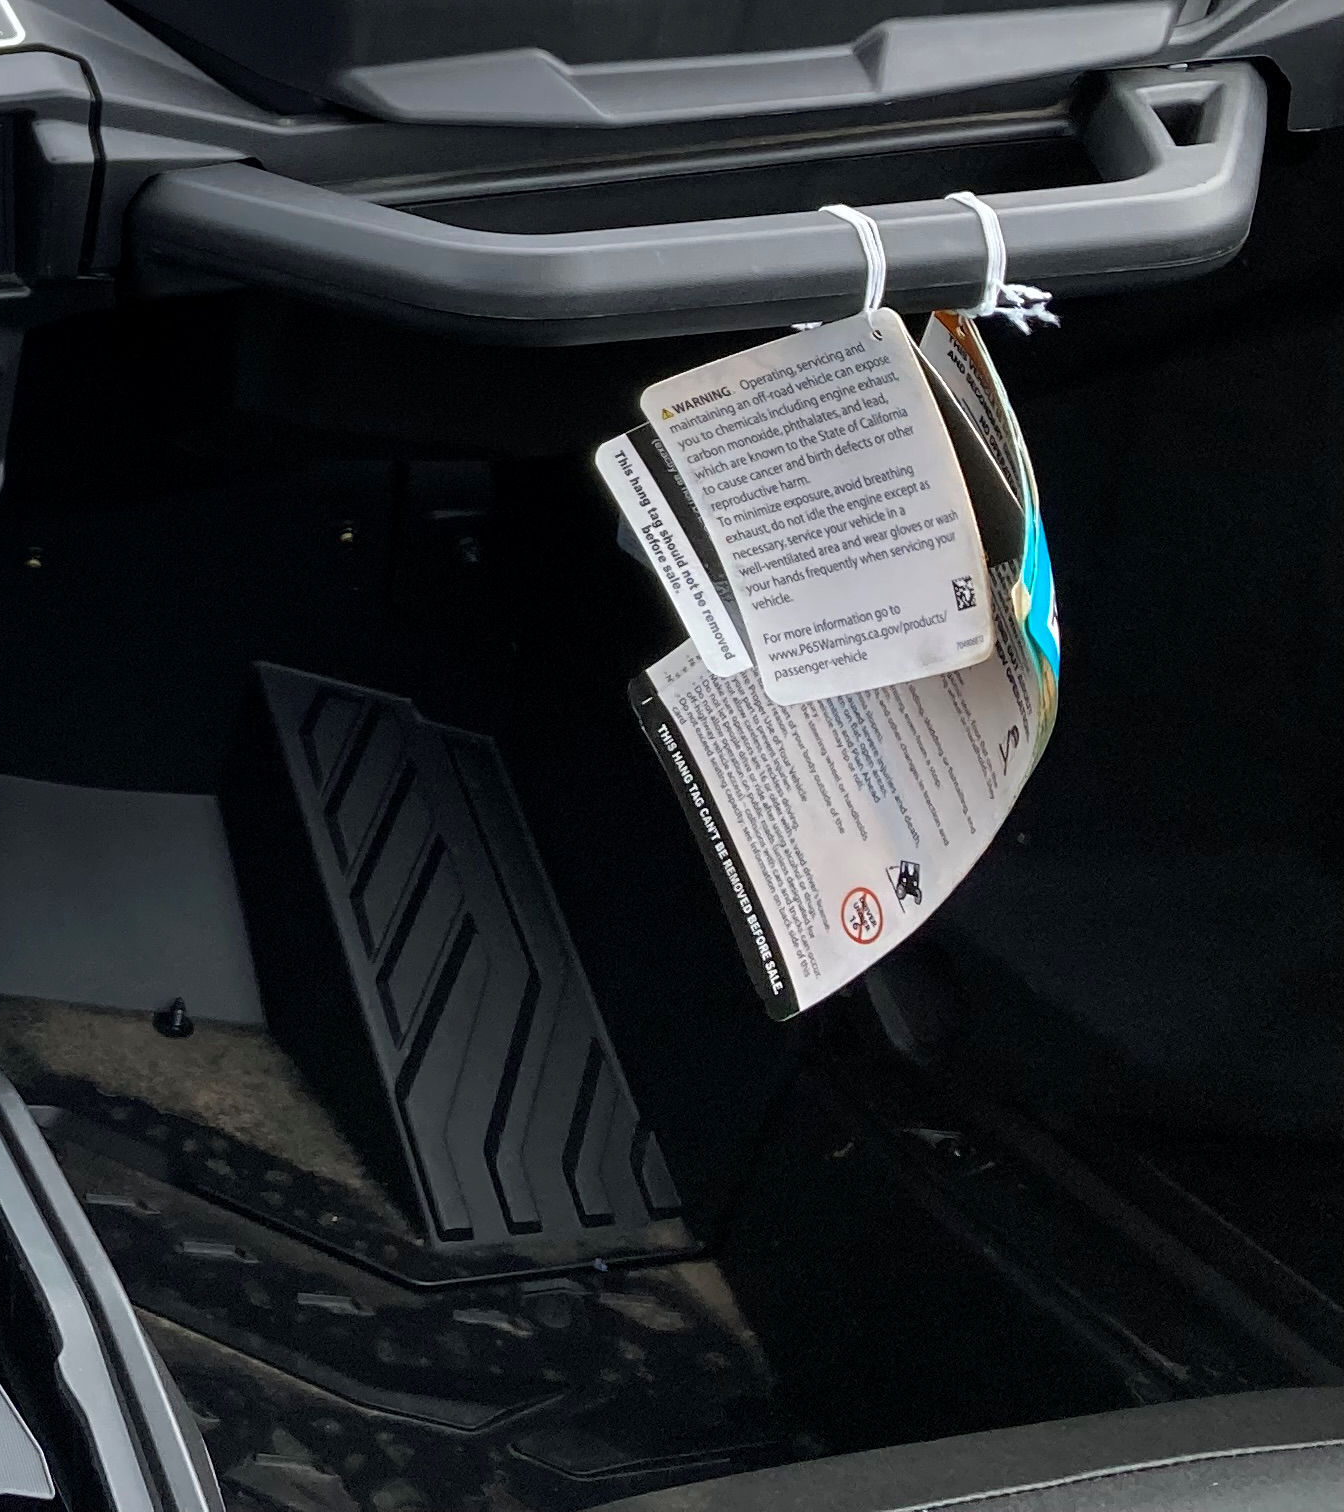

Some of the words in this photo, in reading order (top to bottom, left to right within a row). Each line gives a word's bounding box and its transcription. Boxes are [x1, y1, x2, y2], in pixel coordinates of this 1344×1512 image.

[669, 404, 736, 433] maintaining
[735, 399, 751, 410] an
[751, 383, 794, 405] off-road
[794, 372, 833, 390] vehicle
[834, 366, 854, 379] can
[854, 355, 891, 372] expose
[739, 366, 797, 390] Operating,
[796, 350, 845, 372] servicing
[844, 341, 865, 356] and
[676, 435, 700, 450] you
[699, 430, 713, 440] to
[714, 411, 768, 436] chemicals
[768, 396, 819, 418] including
[819, 384, 856, 402] engine
[857, 371, 899, 391] exhaust,
[686, 445, 726, 464] carbon
[726, 427, 783, 450] monoxide,
[782, 409, 841, 436] phthalates,
[840, 400, 862, 415] and
[861, 393, 888, 408] lead,
[693, 460, 729, 479] which
[729, 456, 747, 468] are
[746, 445, 785, 462] known
[785, 441, 798, 451] to
[798, 435, 817, 447] the
[817, 426, 846, 441] State
[847, 420, 859, 432] of
[859, 407, 908, 428] California
[701, 485, 715, 495] to
[716, 474, 748, 490] cause
[749, 463, 783, 480] cancer
[785, 454, 806, 470] and
[805, 447, 833, 464] birth
[834, 437, 873, 455] defects
[886, 425, 913, 440] other
[710, 484, 778, 511] reproductive
[777, 476, 811, 490] harm.
[715, 515, 732, 527] To
[732, 502, 782, 523] minimize
[783, 488, 834, 508] exposure,
[833, 477, 862, 494] avoid
[862, 465, 914, 486] breathing
[614, 449, 633, 476] This
[629, 476, 651, 507] hang
[647, 507, 663, 528] tag
[659, 529, 688, 568] should
[681, 569, 699, 590] not
[693, 590, 706, 607] be
[701, 609, 735, 660] removed
[640, 522, 666, 563] before
[662, 564, 680, 594] sale.
[762, 632, 781, 645] For
[783, 626, 812, 640] more
[812, 611, 873, 633] information
[874, 608, 888, 622] go
[888, 604, 901, 615] to
[773, 648, 867, 681] passenger-vehicle
[657, 724, 678, 752] THIS
[672, 751, 694, 784] HANG
[689, 783, 705, 808] TAG
[699, 808, 721, 841] CAN'T
[715, 841, 729, 860] BE
[722, 858, 753, 914] REMOVED
[747, 914, 773, 961] BEFORE
[765, 960, 784, 995] SALE.
